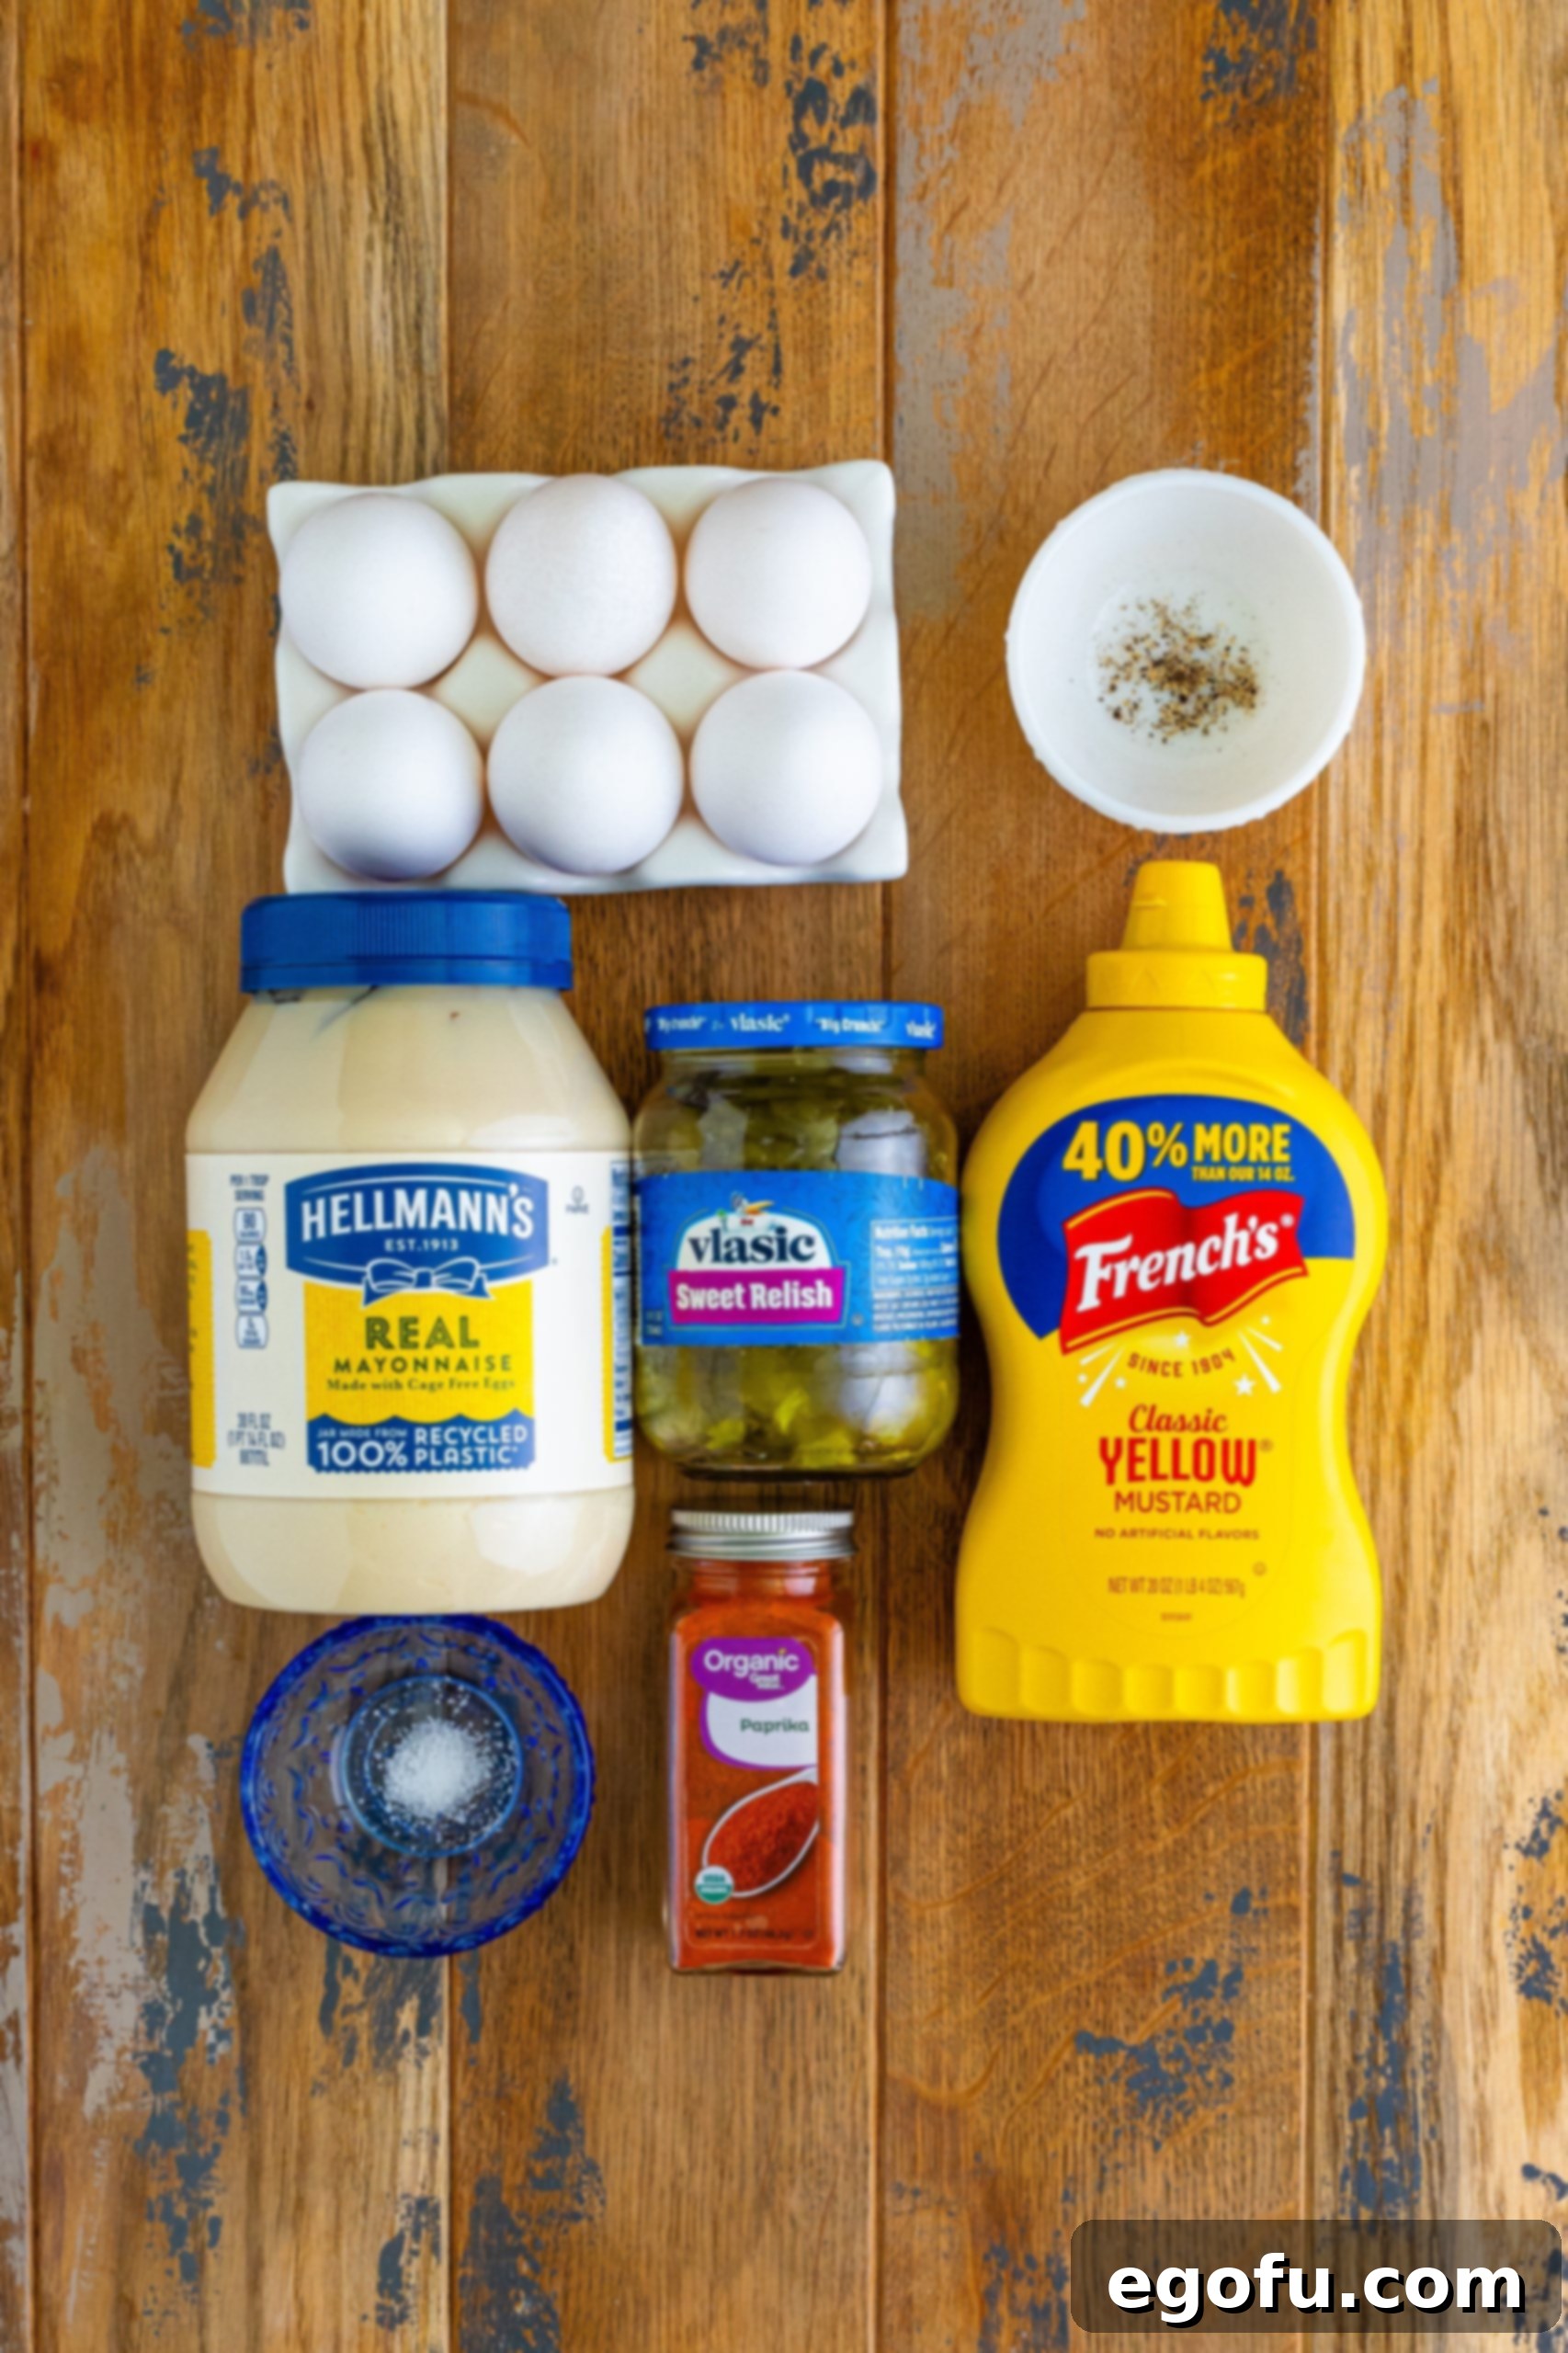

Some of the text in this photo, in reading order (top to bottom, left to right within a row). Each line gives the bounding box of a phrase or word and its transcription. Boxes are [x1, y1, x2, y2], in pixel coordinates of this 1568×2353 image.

[1062, 1120, 1291, 1182] 40% MORE
[301, 1182, 534, 1243] HELLMANN'S
[688, 1226, 816, 1264] vlasic
[1074, 1211, 1278, 1313] French's
[676, 1279, 834, 1311] Sweet Relish
[365, 1315, 481, 1350] REAL
[333, 1355, 513, 1374] MAYONNAISE
[1127, 1347, 1235, 1378] SINCE 1904
[326, 1376, 516, 1394] Made with Cage Free Eggs
[318, 1428, 336, 1438] JAR
[1128, 1404, 1229, 1434] Classic
[415, 1426, 528, 1446] RECYCLED
[317, 1440, 408, 1468] 100%
[1098, 1436, 1257, 1487] YELLOW
[1114, 1491, 1243, 1515] MUSTARD
[1094, 1528, 1260, 1540] NO ARTIFICIAL FLAVORS
[702, 1648, 801, 1678] Organic
[739, 1718, 811, 1735] Paprika
